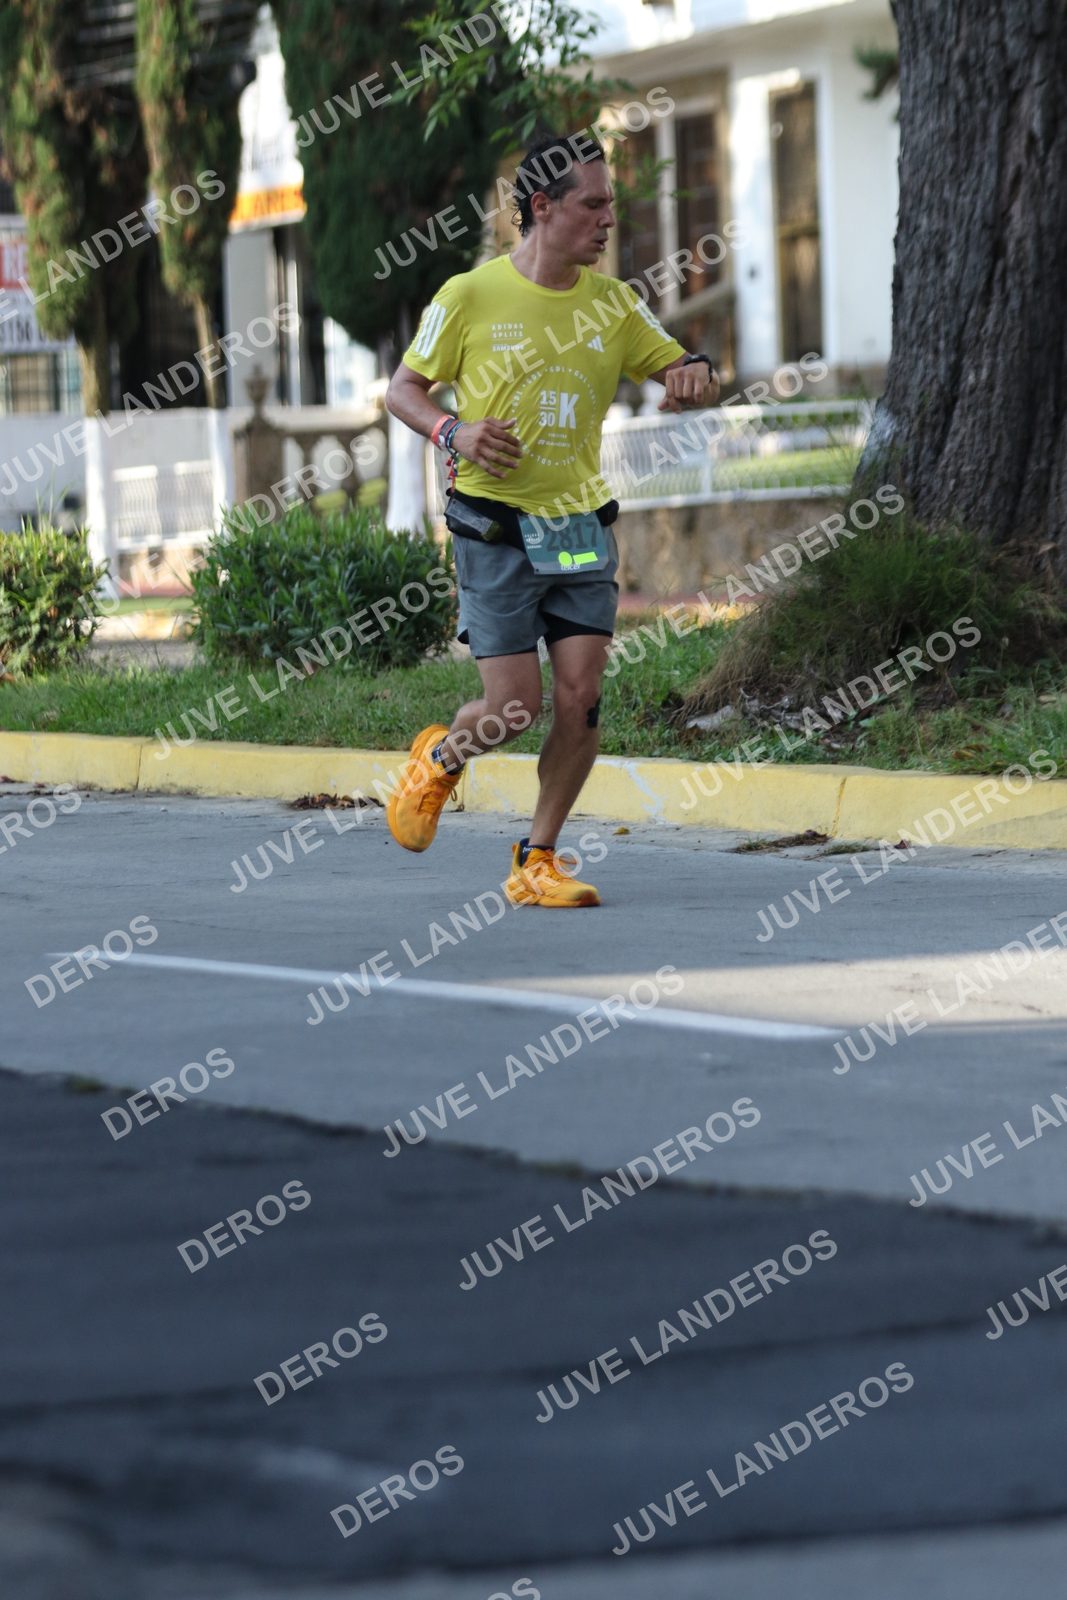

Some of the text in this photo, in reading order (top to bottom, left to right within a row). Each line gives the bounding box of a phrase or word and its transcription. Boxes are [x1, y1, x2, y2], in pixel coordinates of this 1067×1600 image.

[539, 390, 556, 405] 15
[538, 411, 556, 427] 30
[558, 392, 580, 429] K
[544, 521, 598, 551] 2817
